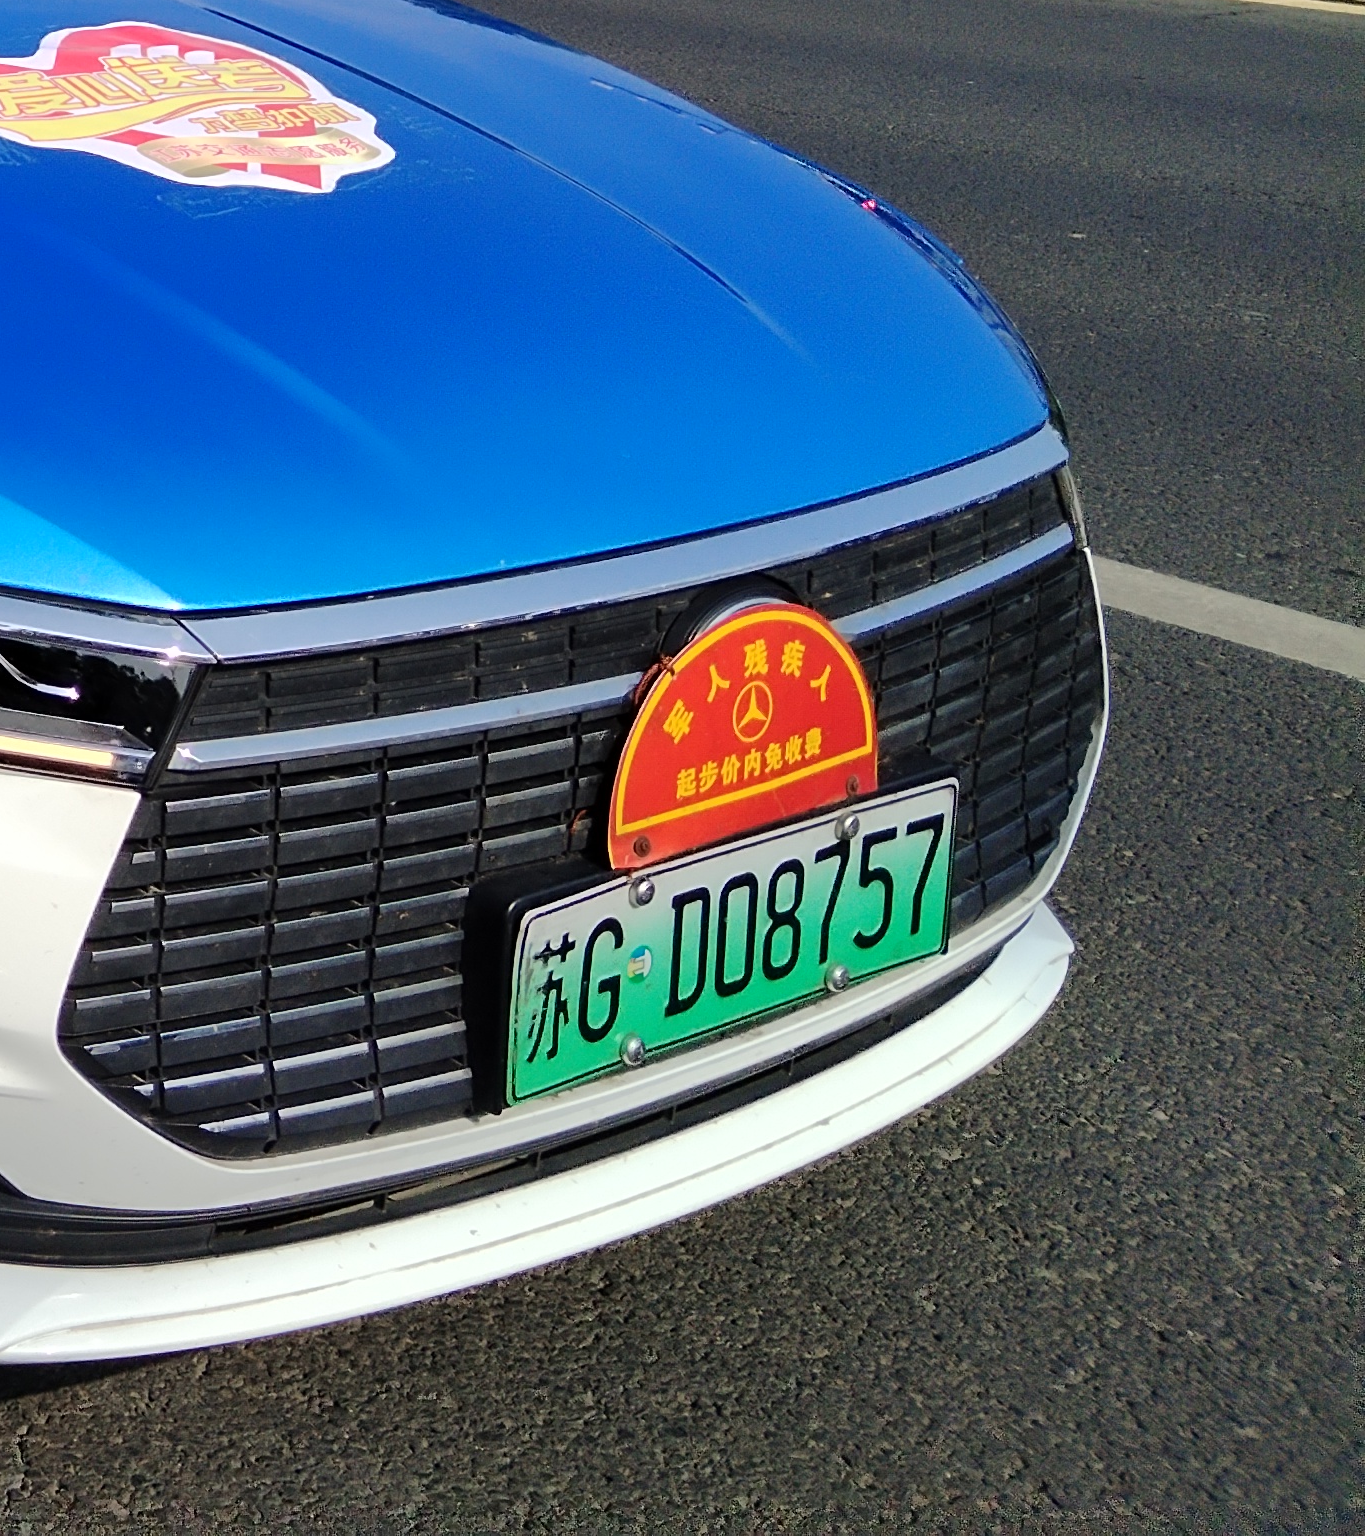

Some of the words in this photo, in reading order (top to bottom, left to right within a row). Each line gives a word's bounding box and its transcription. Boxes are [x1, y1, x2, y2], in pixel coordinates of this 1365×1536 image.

[189, 104, 361, 134] 为梦护航
[149, 137, 367, 163] 江苏交通志愿服务
[663, 639, 831, 745] 军人残疾人
[676, 727, 822, 800] 起步价内免收费
